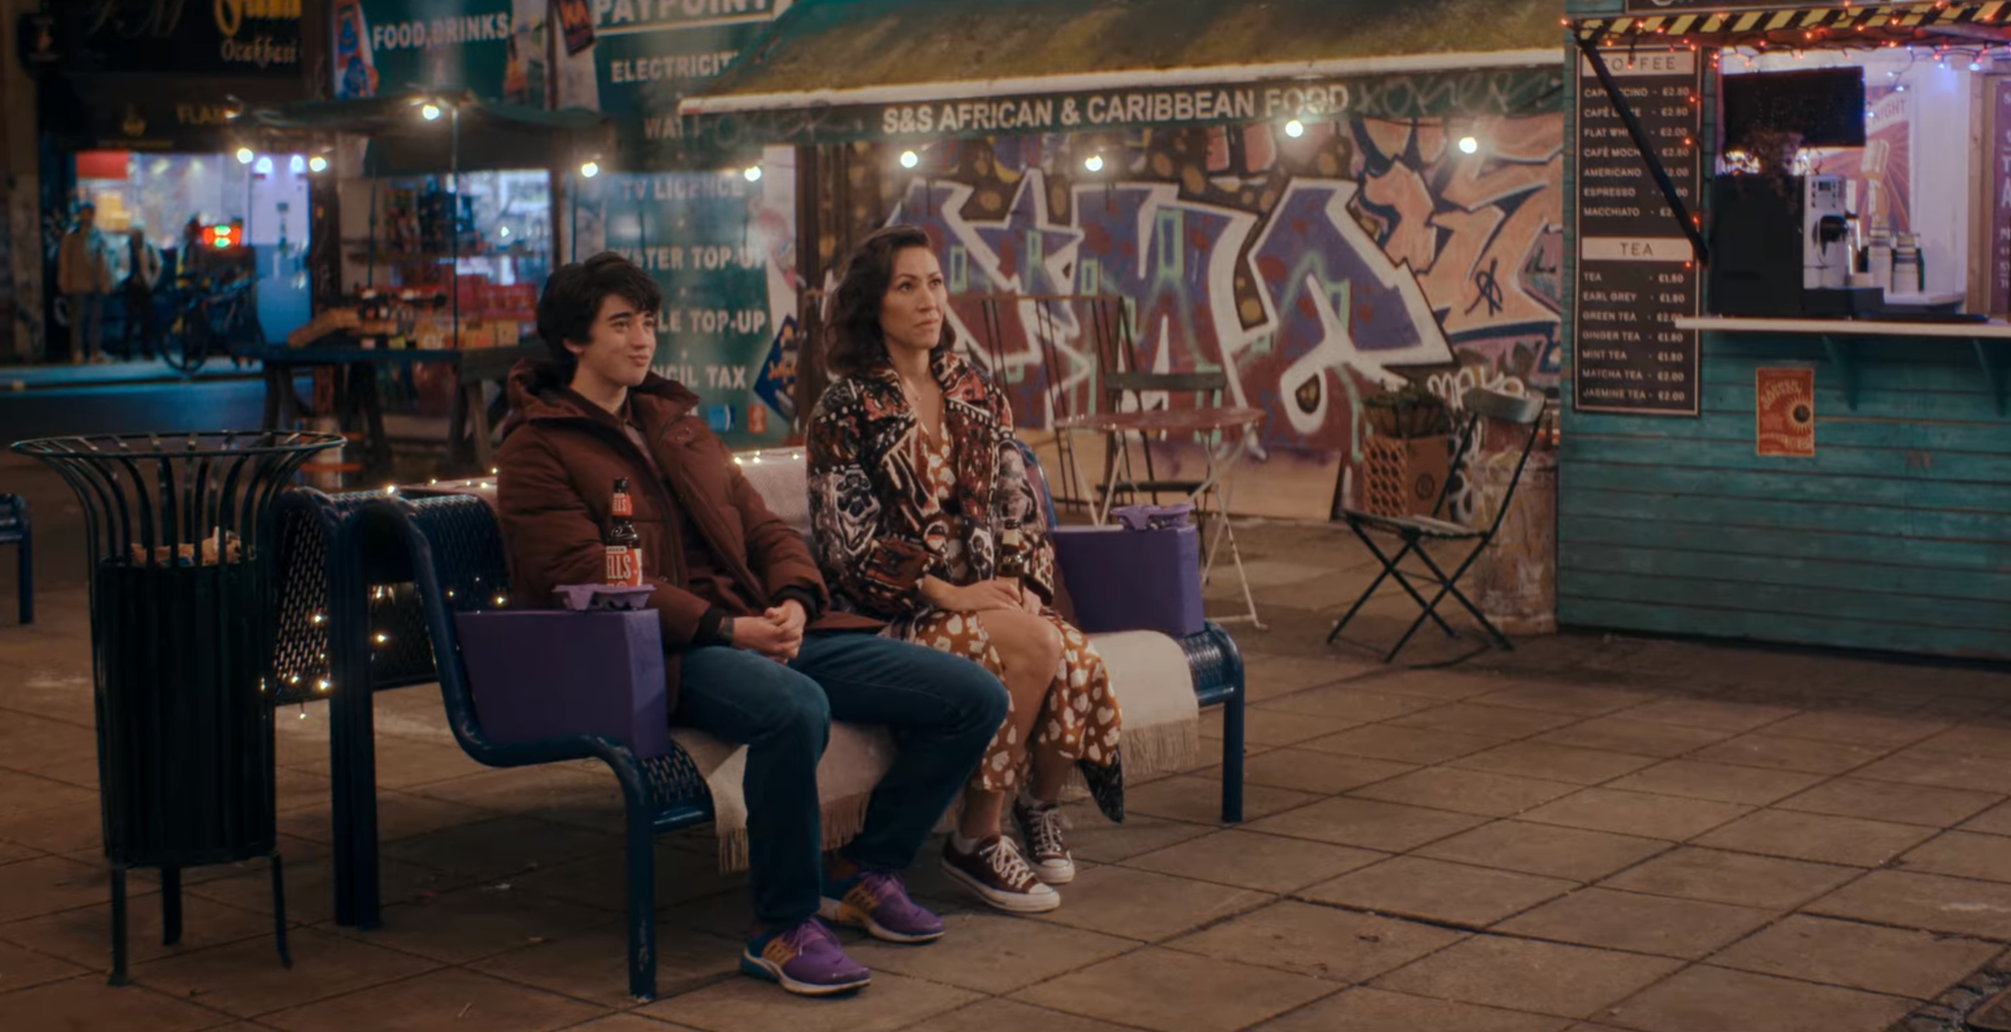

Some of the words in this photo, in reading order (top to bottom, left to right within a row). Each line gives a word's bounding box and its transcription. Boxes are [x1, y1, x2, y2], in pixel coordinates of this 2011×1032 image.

[611, 50, 738, 83] ELECTRICIT
[1603, 57, 1676, 72] OFEE
[1584, 86, 1649, 98] CAPCINO
[882, 106, 934, 135] S&S
[938, 99, 1054, 132] AFRICAN
[1060, 96, 1082, 127] &
[1087, 89, 1255, 125] CARIBBEAN
[1264, 83, 1350, 118] FOOD
[1583, 127, 1607, 138] FLAT
[1609, 127, 1629, 138] WHI
[1611, 147, 1642, 158] MOCH
[1583, 167, 1642, 178] AMERICANO
[1663, 167, 1690, 178] 2.00
[621, 179, 648, 199] TV
[1583, 187, 1637, 198] ESPRESSO
[1583, 207, 1641, 218] MACCHIATO
[1619, 242, 1654, 257] TEA
[611, 246, 684, 271] YSTER
[1583, 272, 1602, 282] TEA
[1583, 291, 1608, 302] EARL
[1610, 292, 1637, 303] GREY
[690, 309, 766, 334] TOP-UP
[1582, 311, 1616, 322] GREEN
[1618, 312, 1637, 322] TEA
[1582, 331, 1619, 341] GINGER
[1621, 332, 1641, 342] TEA
[1582, 350, 1605, 360] MINT
[1608, 351, 1627, 361] TEA
[706, 365, 746, 390] TAX
[1582, 369, 1622, 381] MATCHA
[1624, 370, 1643, 381] TEA
[1582, 388, 1626, 400] JASMINE
[1627, 390, 1647, 400] TEA
